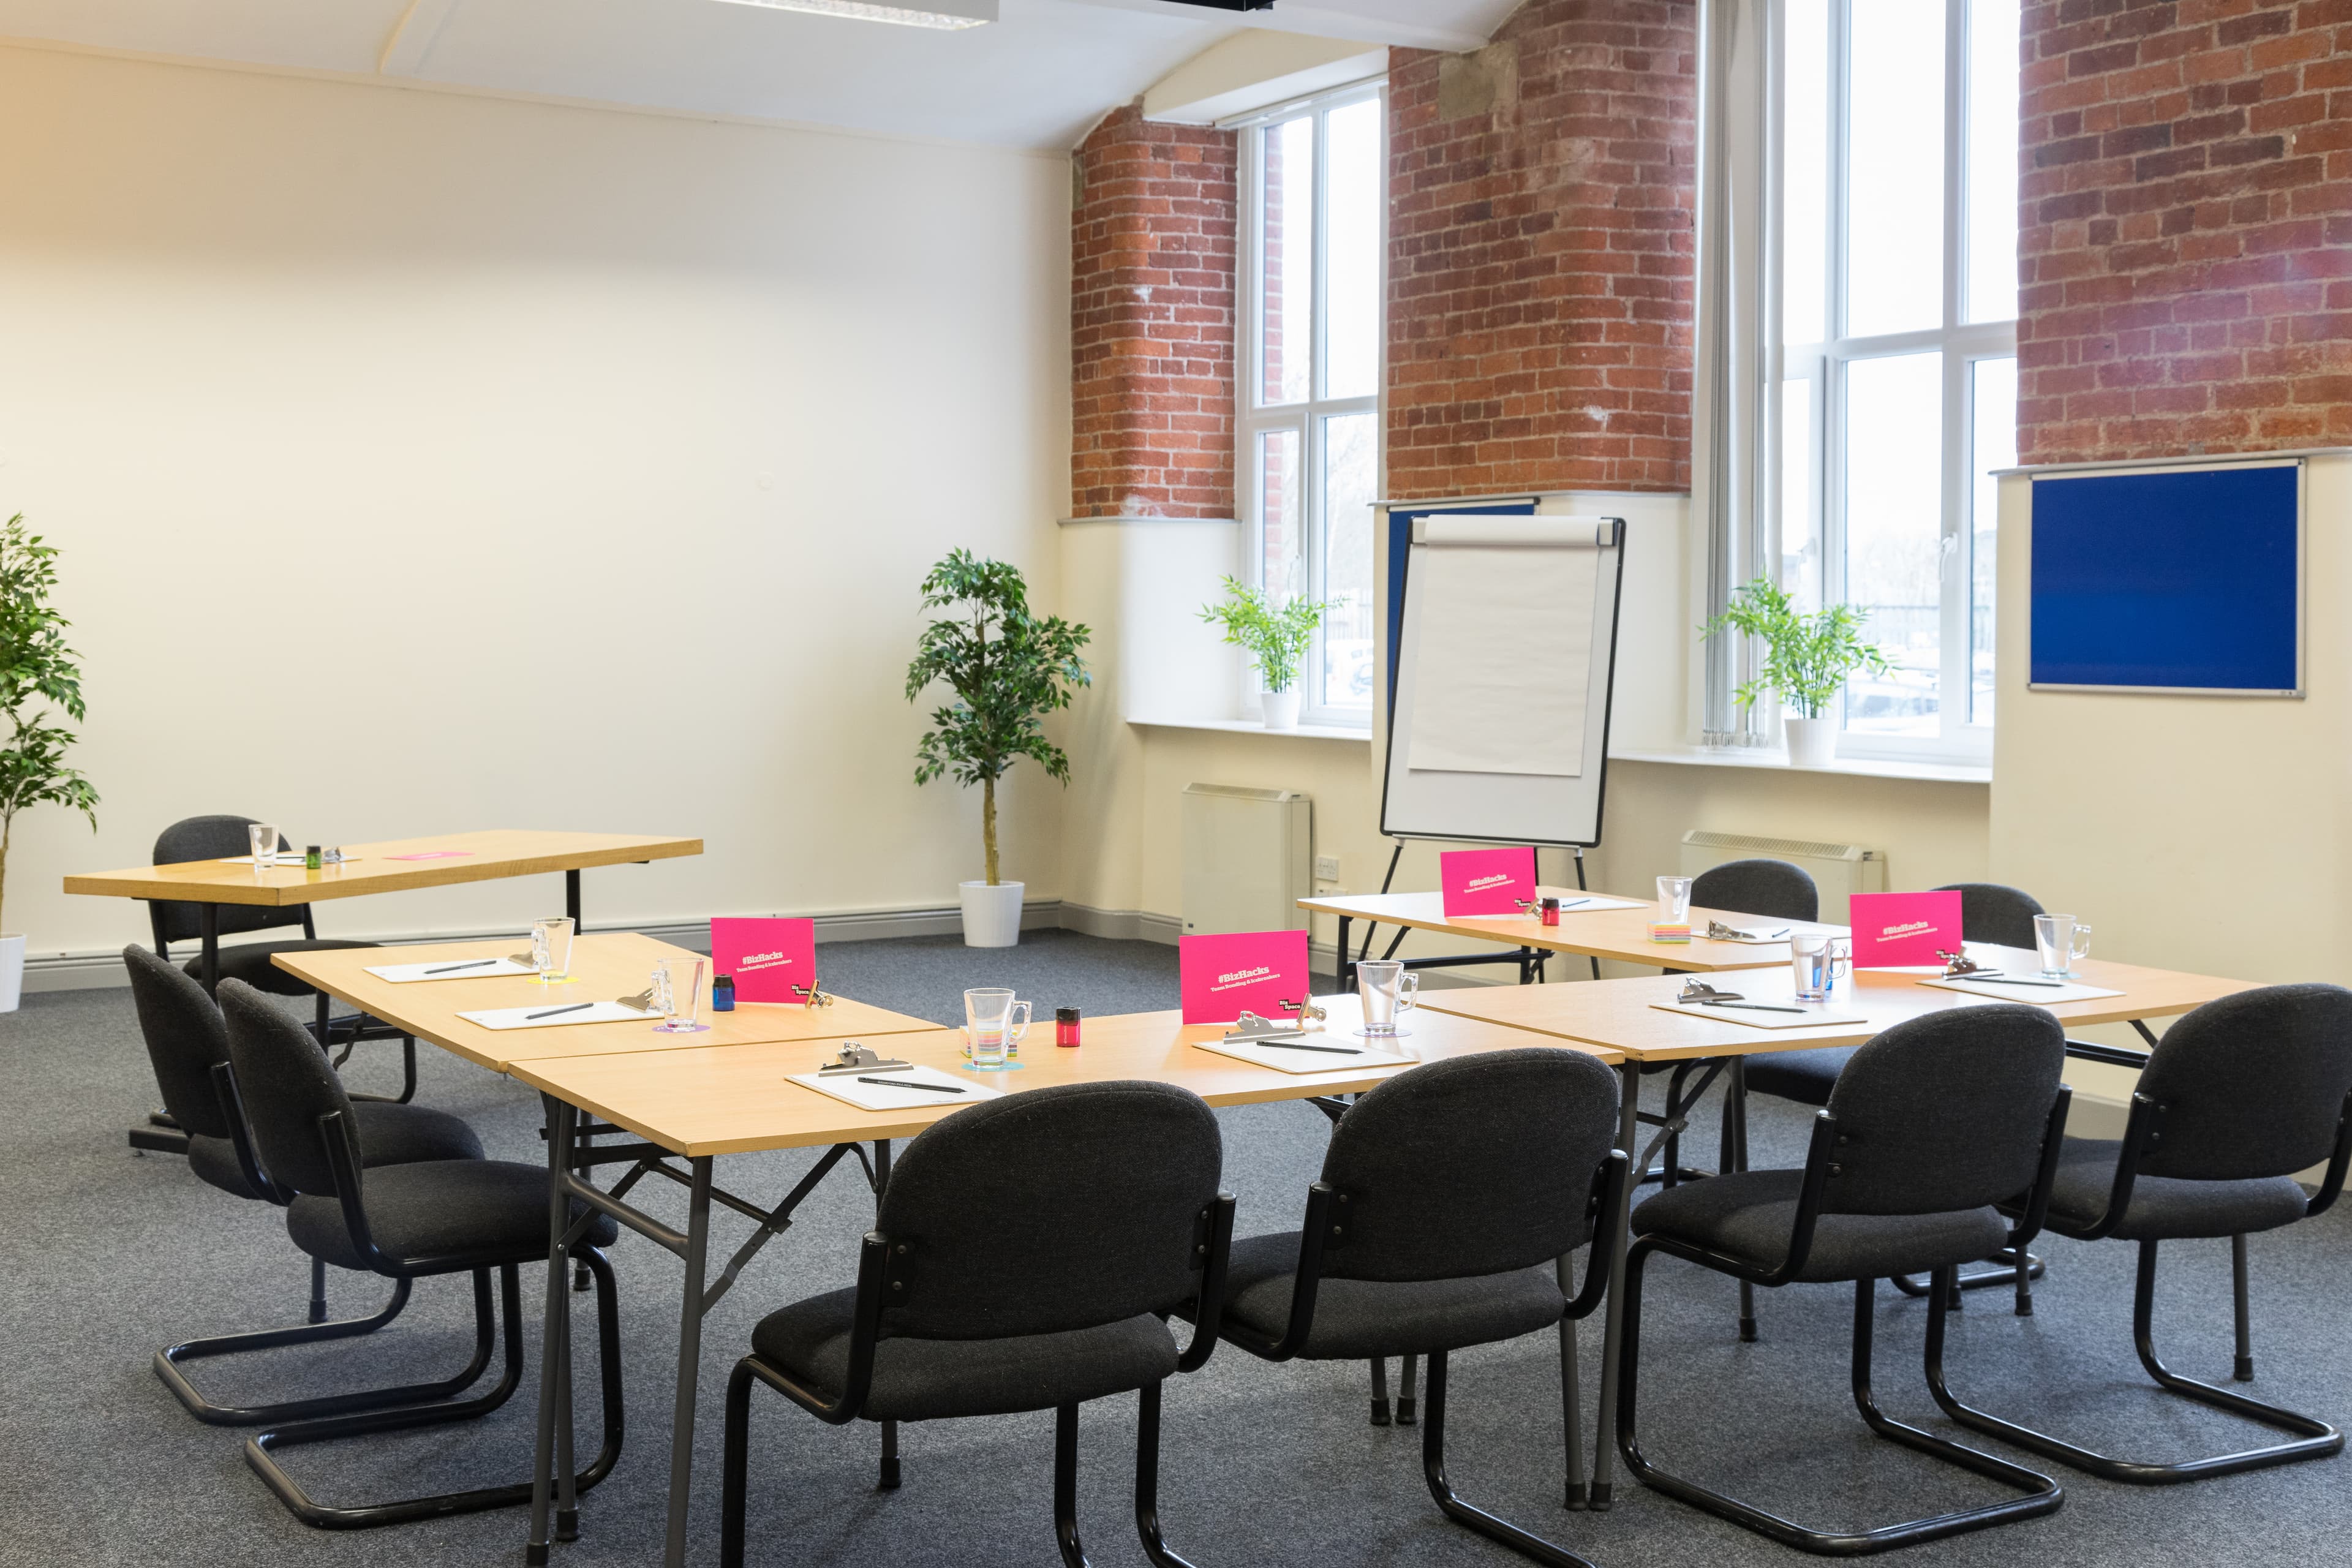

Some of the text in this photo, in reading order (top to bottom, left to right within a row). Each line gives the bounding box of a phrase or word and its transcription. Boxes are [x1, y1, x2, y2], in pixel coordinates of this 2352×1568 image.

[1469, 874, 1507, 888] #BizHacks
[1883, 921, 1928, 935] #BizHacks
[742, 951, 783, 965] #BizHacks
[1218, 967, 1270, 984] #BizHacks
[1251, 973, 1281, 983] Icebreakers
